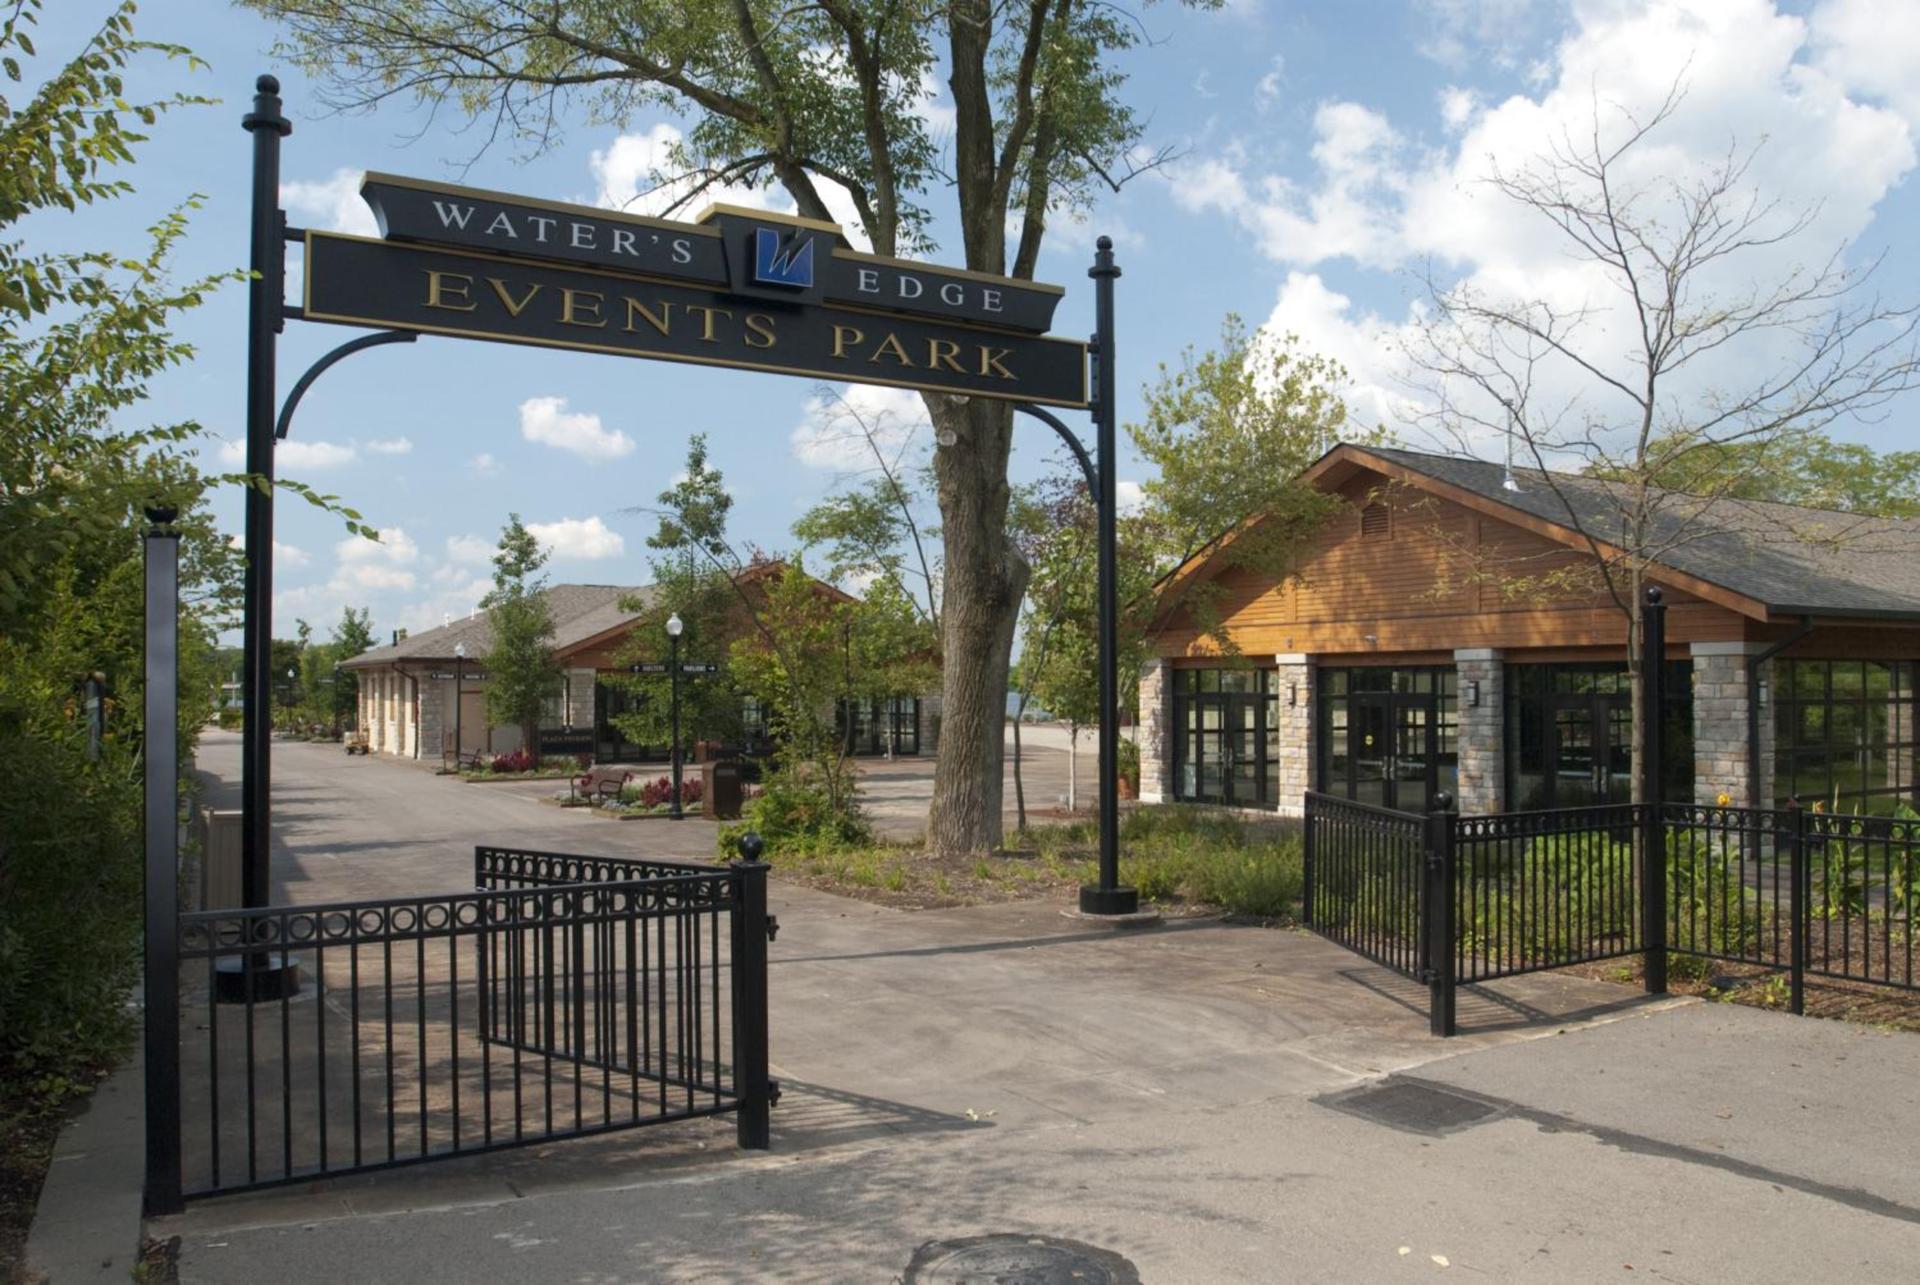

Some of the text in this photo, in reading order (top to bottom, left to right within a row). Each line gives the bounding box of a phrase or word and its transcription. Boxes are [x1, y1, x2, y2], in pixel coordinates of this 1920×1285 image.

[432, 201, 1004, 312] WATER'S EDGE
[420, 270, 1020, 381] EVENTS PARK
